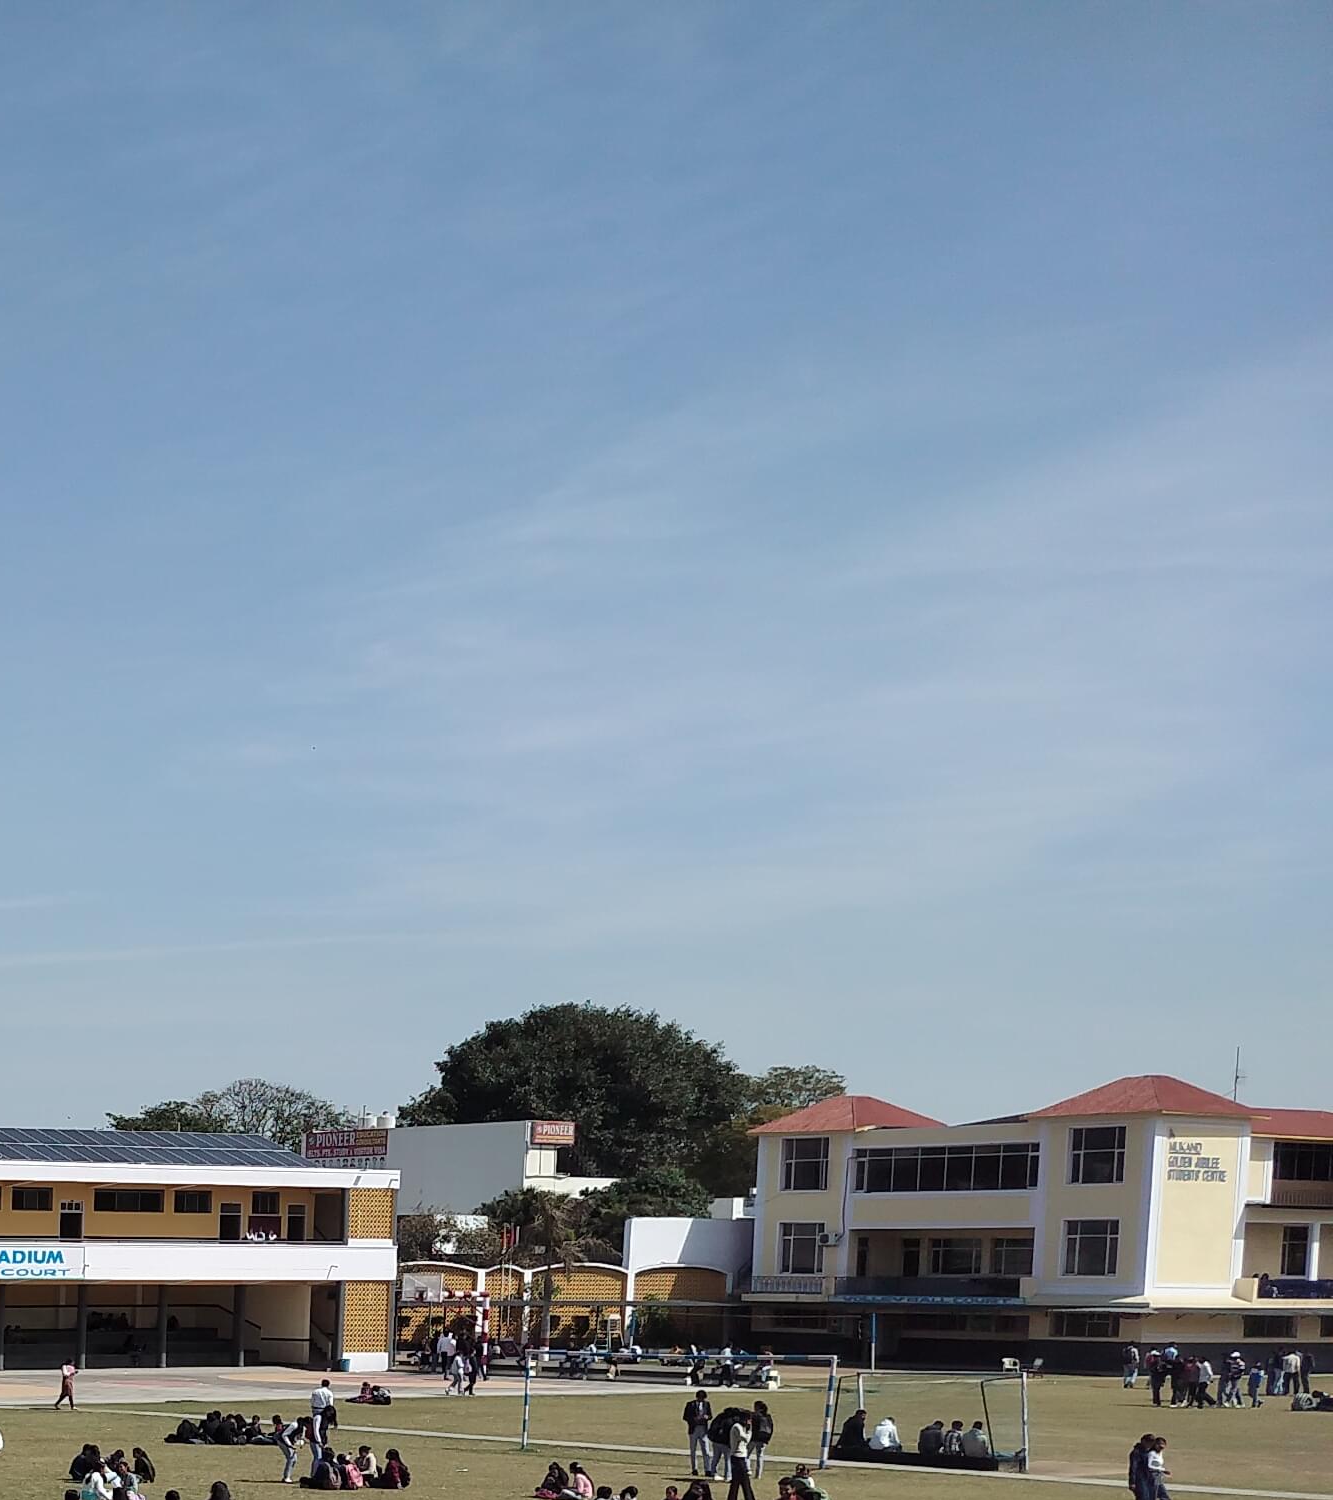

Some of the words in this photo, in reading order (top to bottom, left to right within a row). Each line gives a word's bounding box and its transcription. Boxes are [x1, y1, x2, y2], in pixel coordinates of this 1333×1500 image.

[543, 1124, 574, 1136] PIONEER
[316, 1132, 356, 1147] PIONEER
[1169, 1141, 1202, 1152] MUKAND
[1168, 1155, 1193, 1168] GOLDEN
[1195, 1156, 1221, 1169] JUBILEE
[1202, 1170, 1227, 1182] CENTRE
[0, 1268, 71, 1276] COURT
